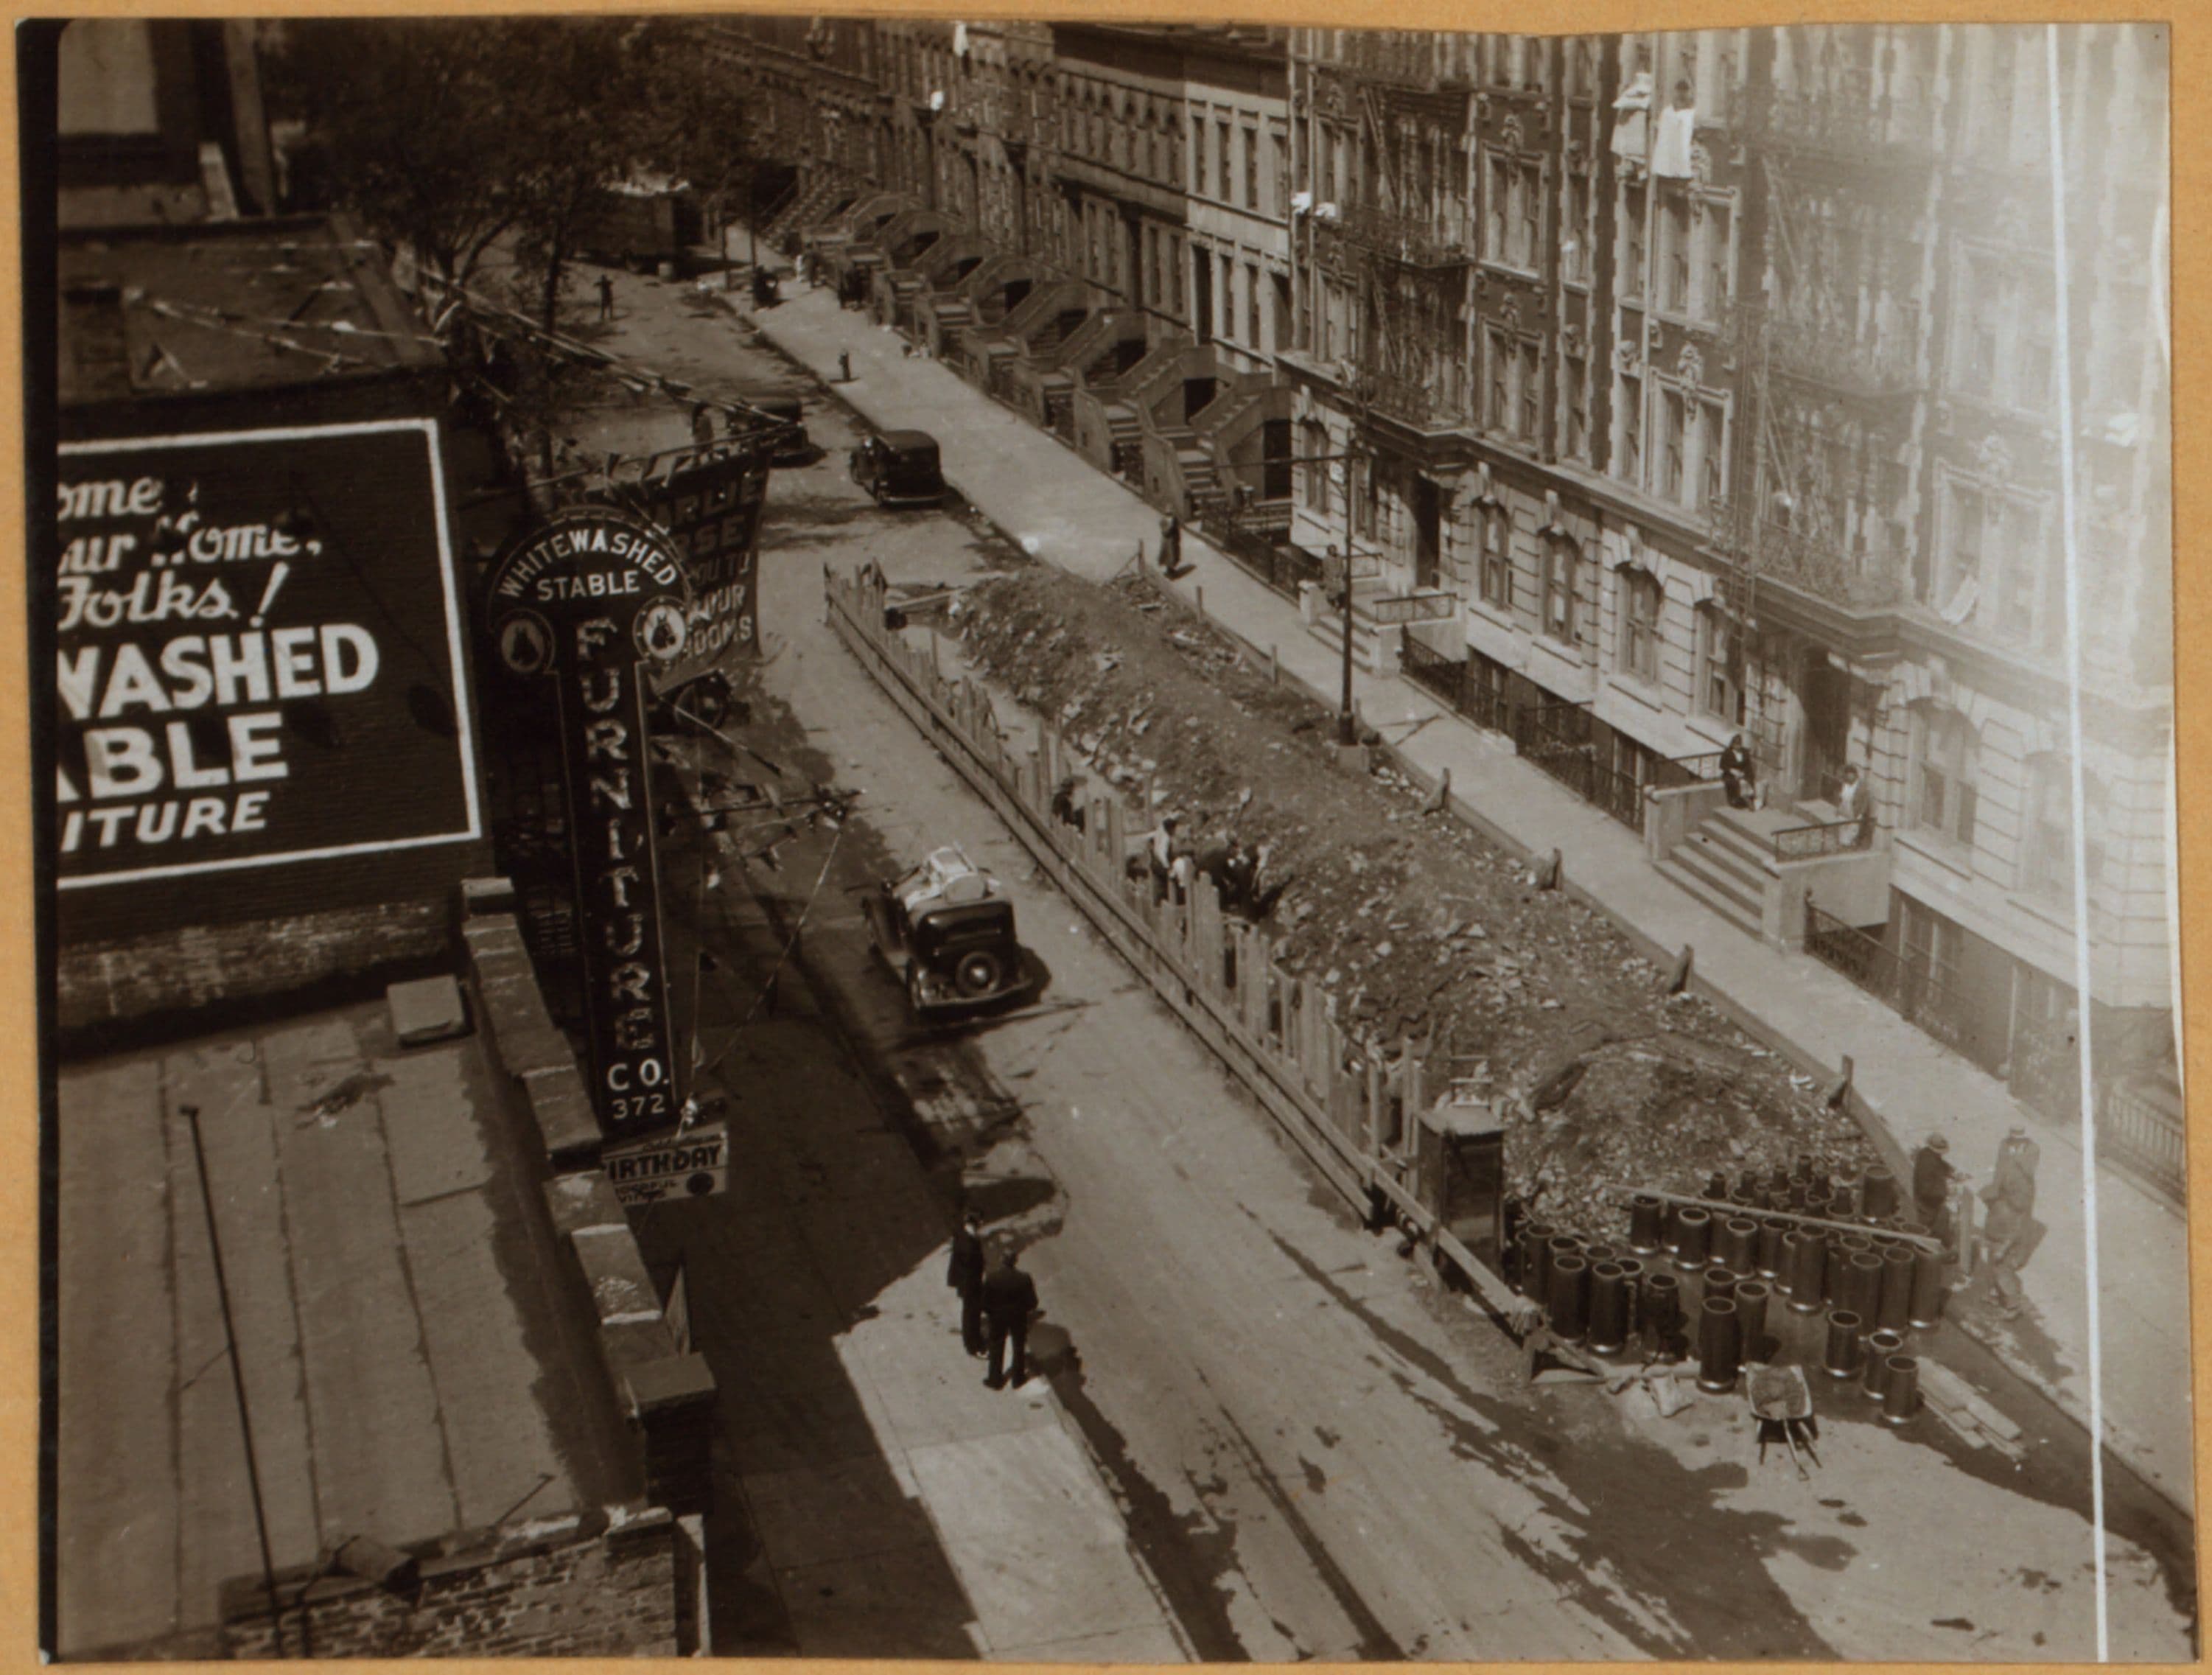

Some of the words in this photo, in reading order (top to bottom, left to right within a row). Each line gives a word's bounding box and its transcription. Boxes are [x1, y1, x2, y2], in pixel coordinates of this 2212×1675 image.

[499, 528, 677, 598] WHITEWASHED
[536, 570, 640, 602] STABLE
[575, 617, 654, 1051] FURNITURE
[606, 1058, 671, 1092] CO.
[612, 1094, 666, 1120] 372
[601, 1145, 722, 1179] IRTHDAY
